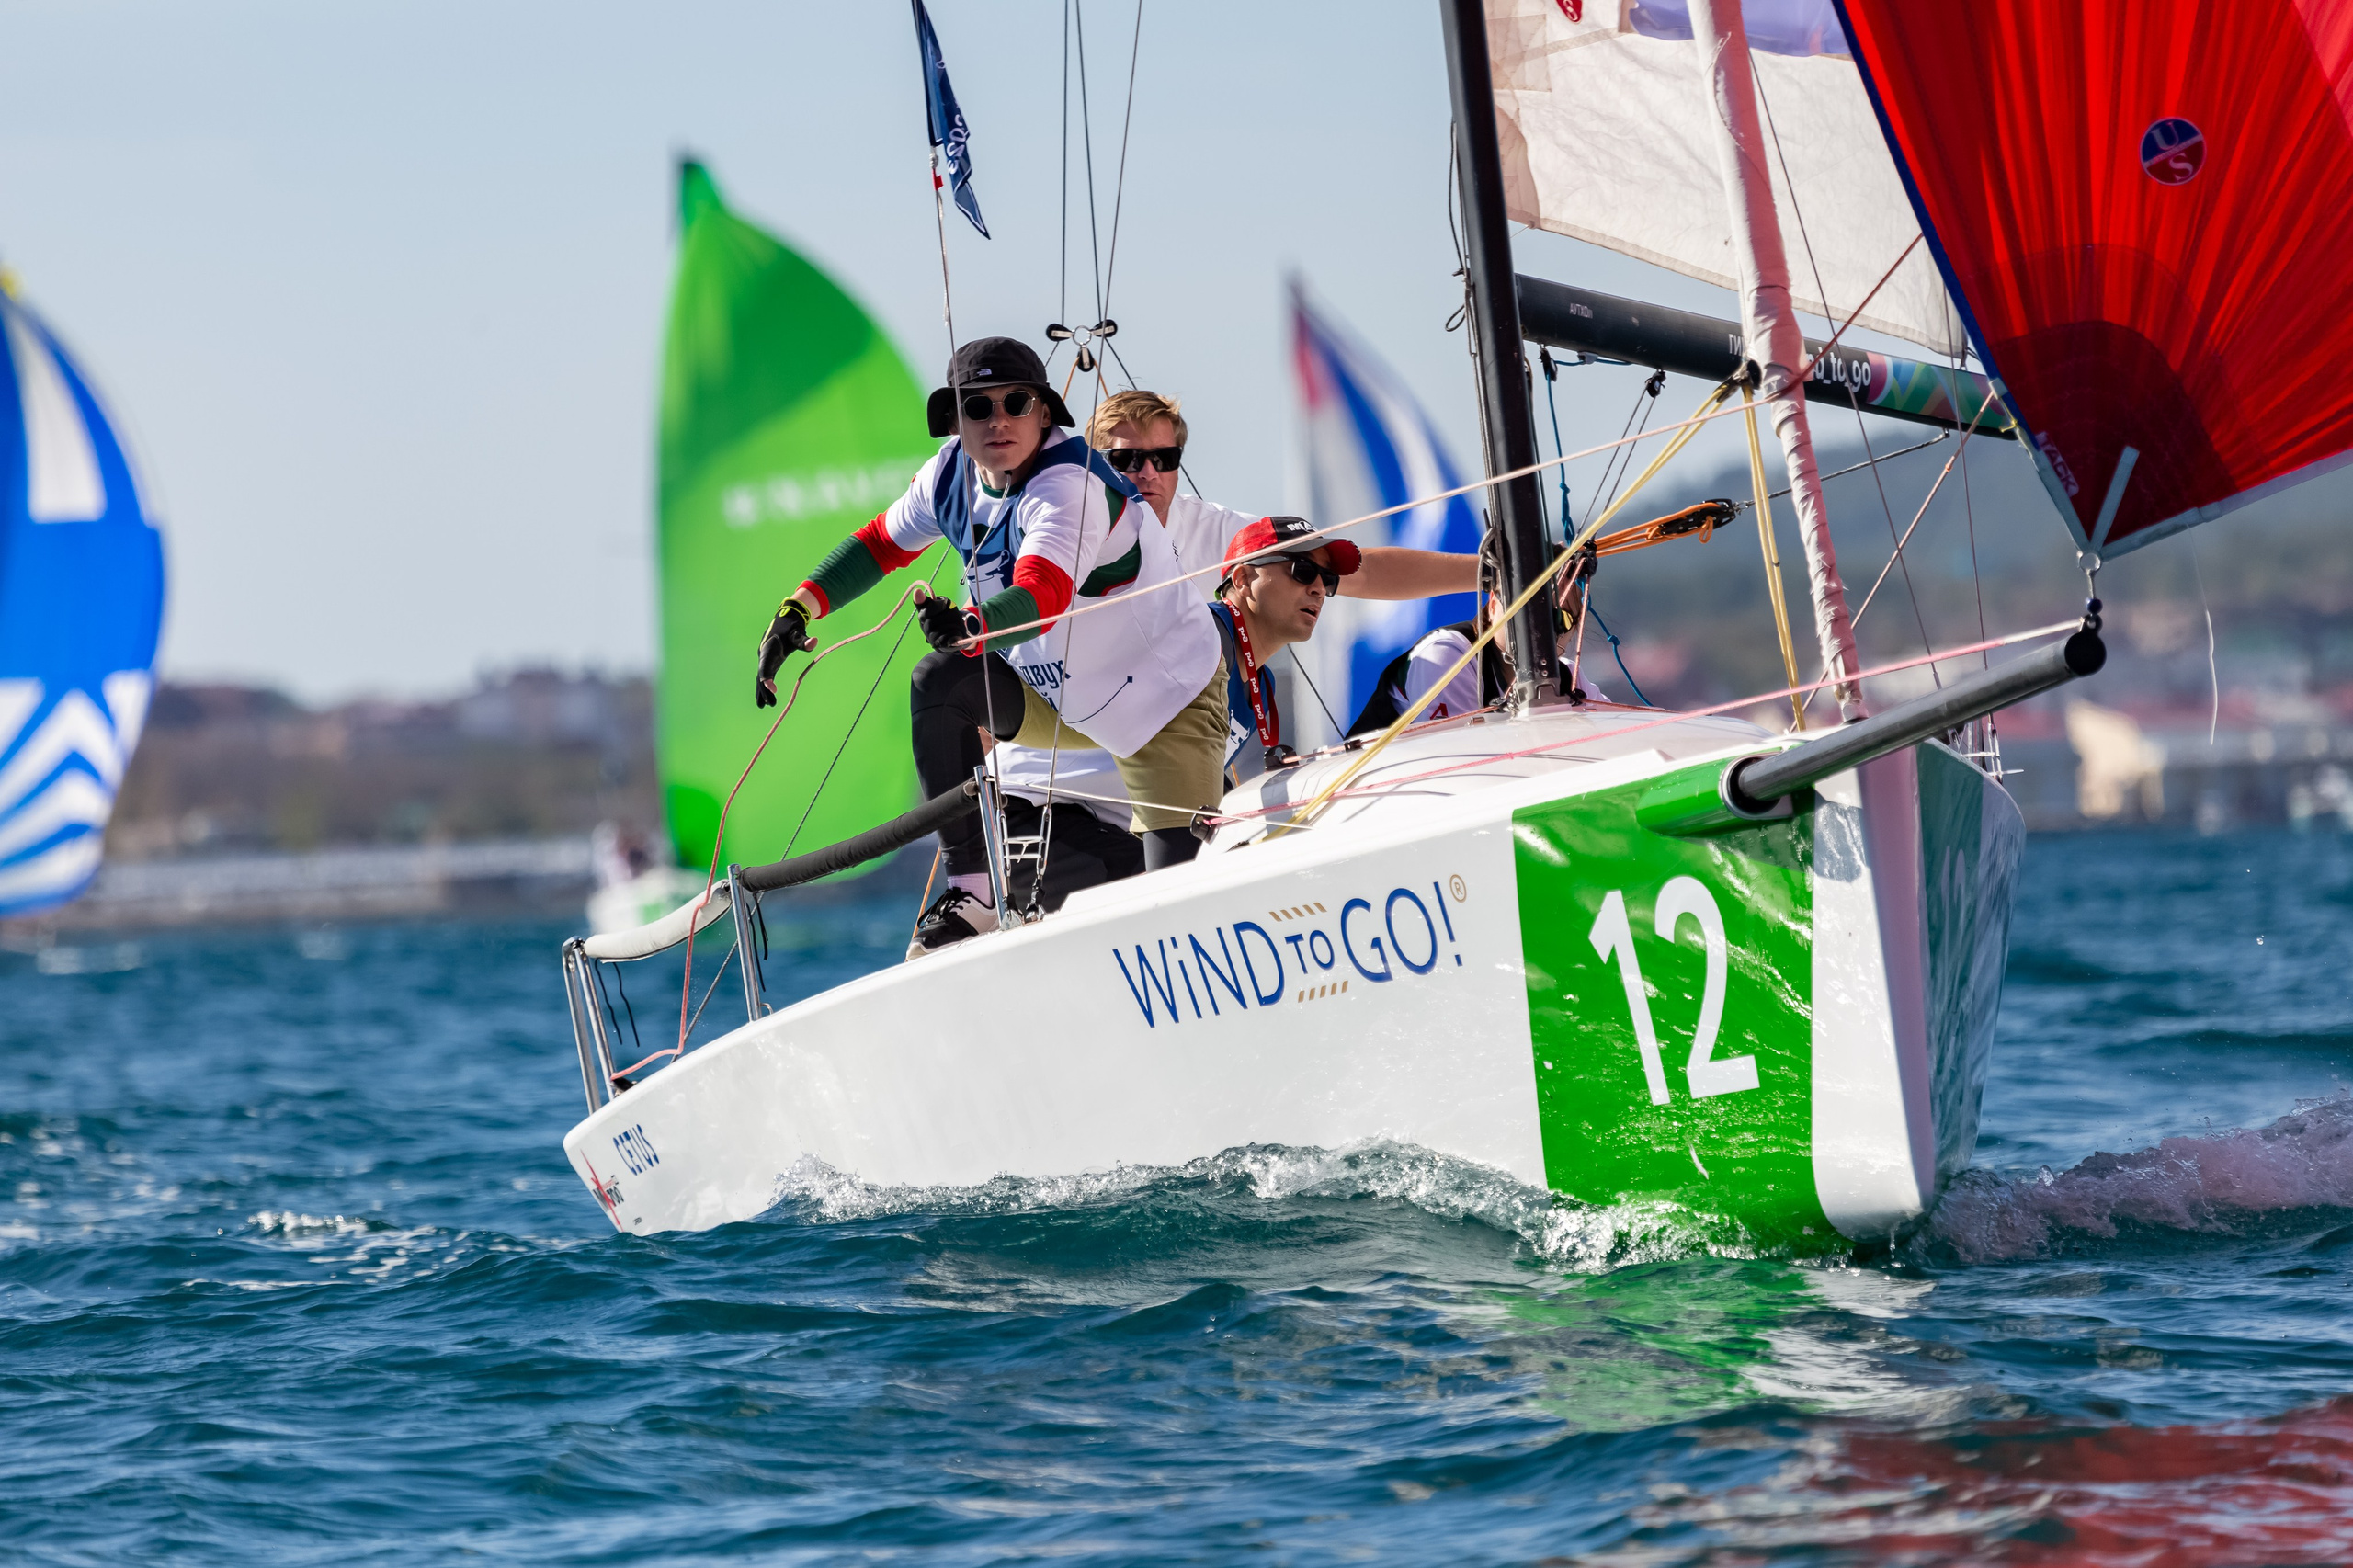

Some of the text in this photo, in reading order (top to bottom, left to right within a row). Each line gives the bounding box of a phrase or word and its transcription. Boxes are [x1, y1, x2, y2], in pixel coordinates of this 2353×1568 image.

[1285, 928, 1335, 975] TO
[1588, 876, 1760, 1107] 12
[613, 1124, 659, 1176] CETUS
